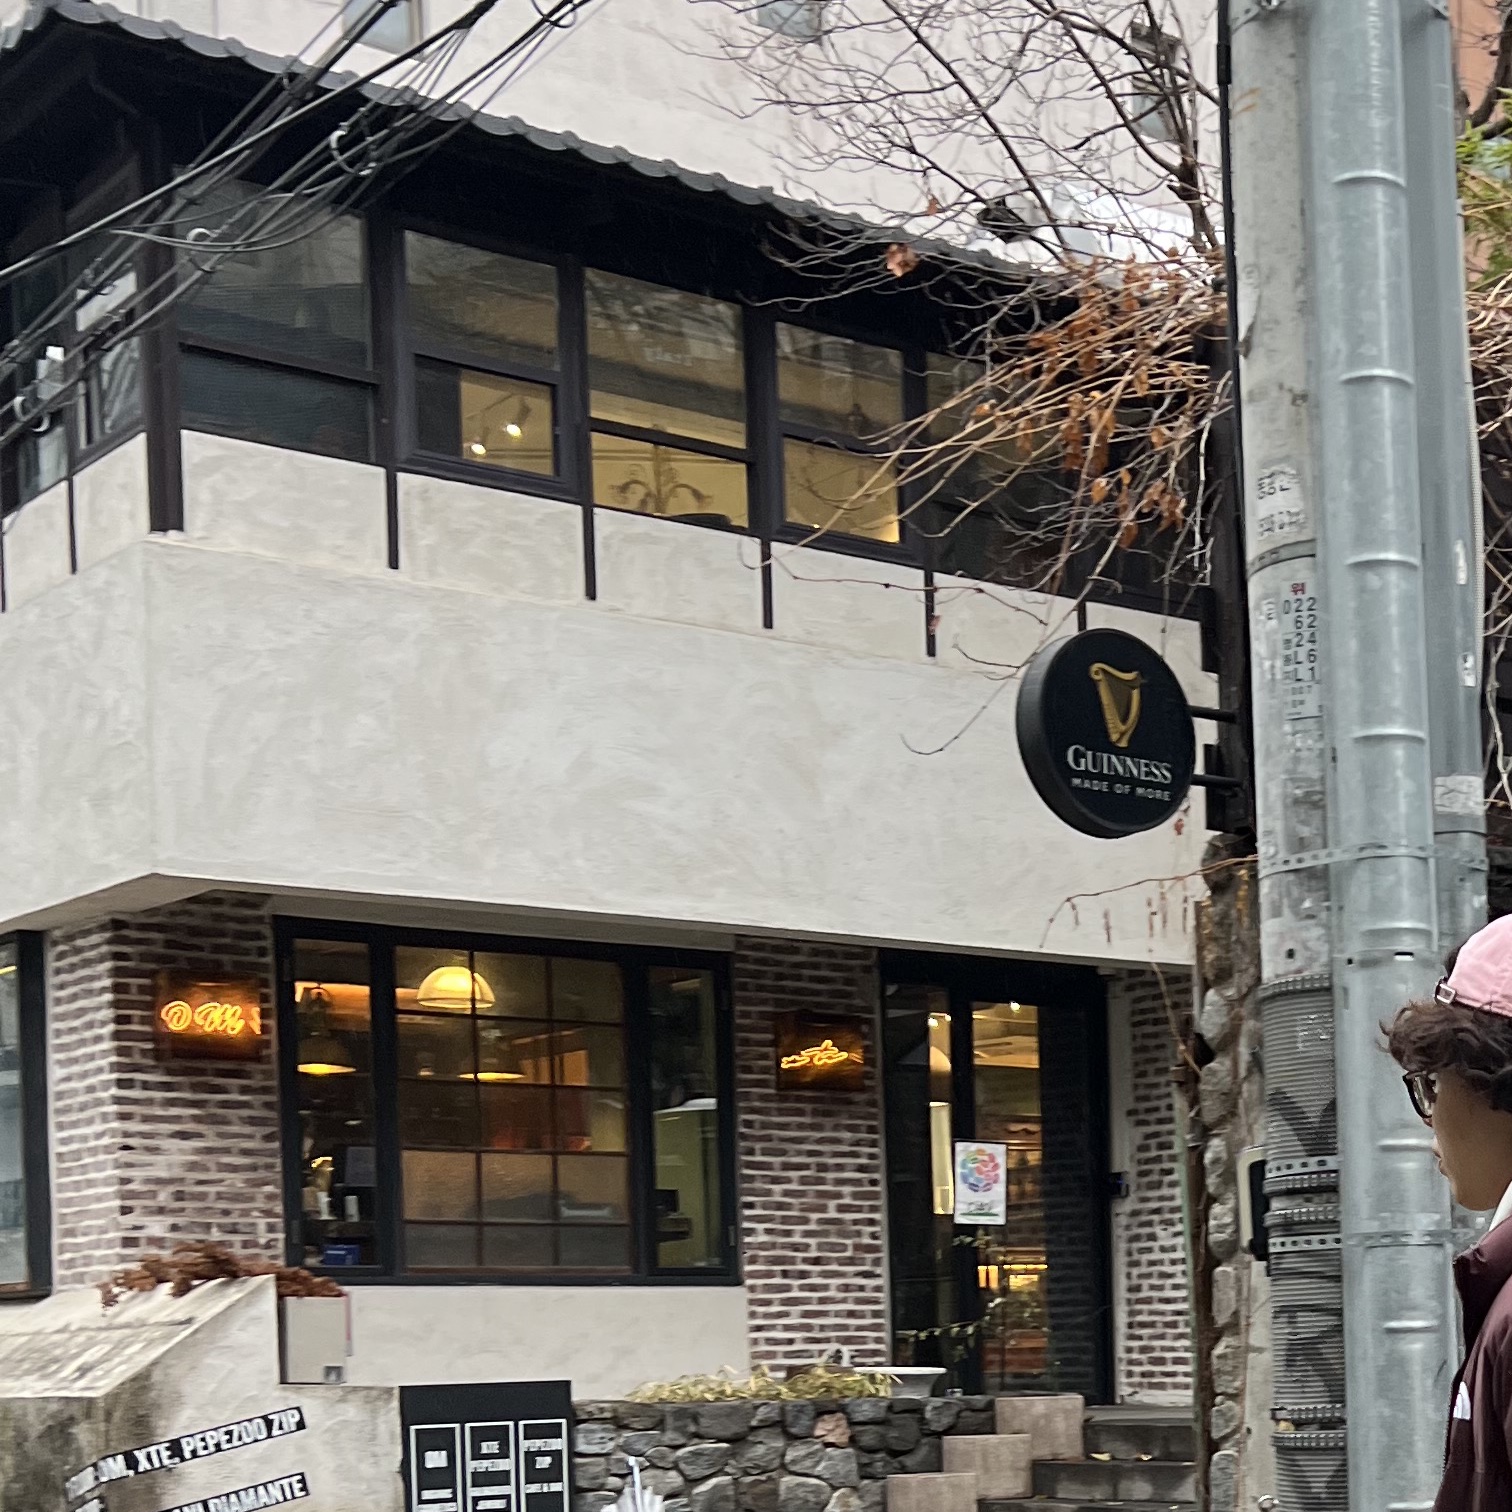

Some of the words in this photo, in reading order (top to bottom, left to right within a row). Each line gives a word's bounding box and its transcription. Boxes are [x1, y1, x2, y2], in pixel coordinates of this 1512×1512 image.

[1066, 744, 1173, 784] GUINNESS
[1071, 777, 1109, 792] MADE
[1113, 783, 1132, 795] OF
[1135, 786, 1171, 802] MORE
[133, 1441, 180, 1473] XTE,
[179, 1417, 268, 1460] PEPEZOO
[267, 1408, 302, 1438] ZIP
